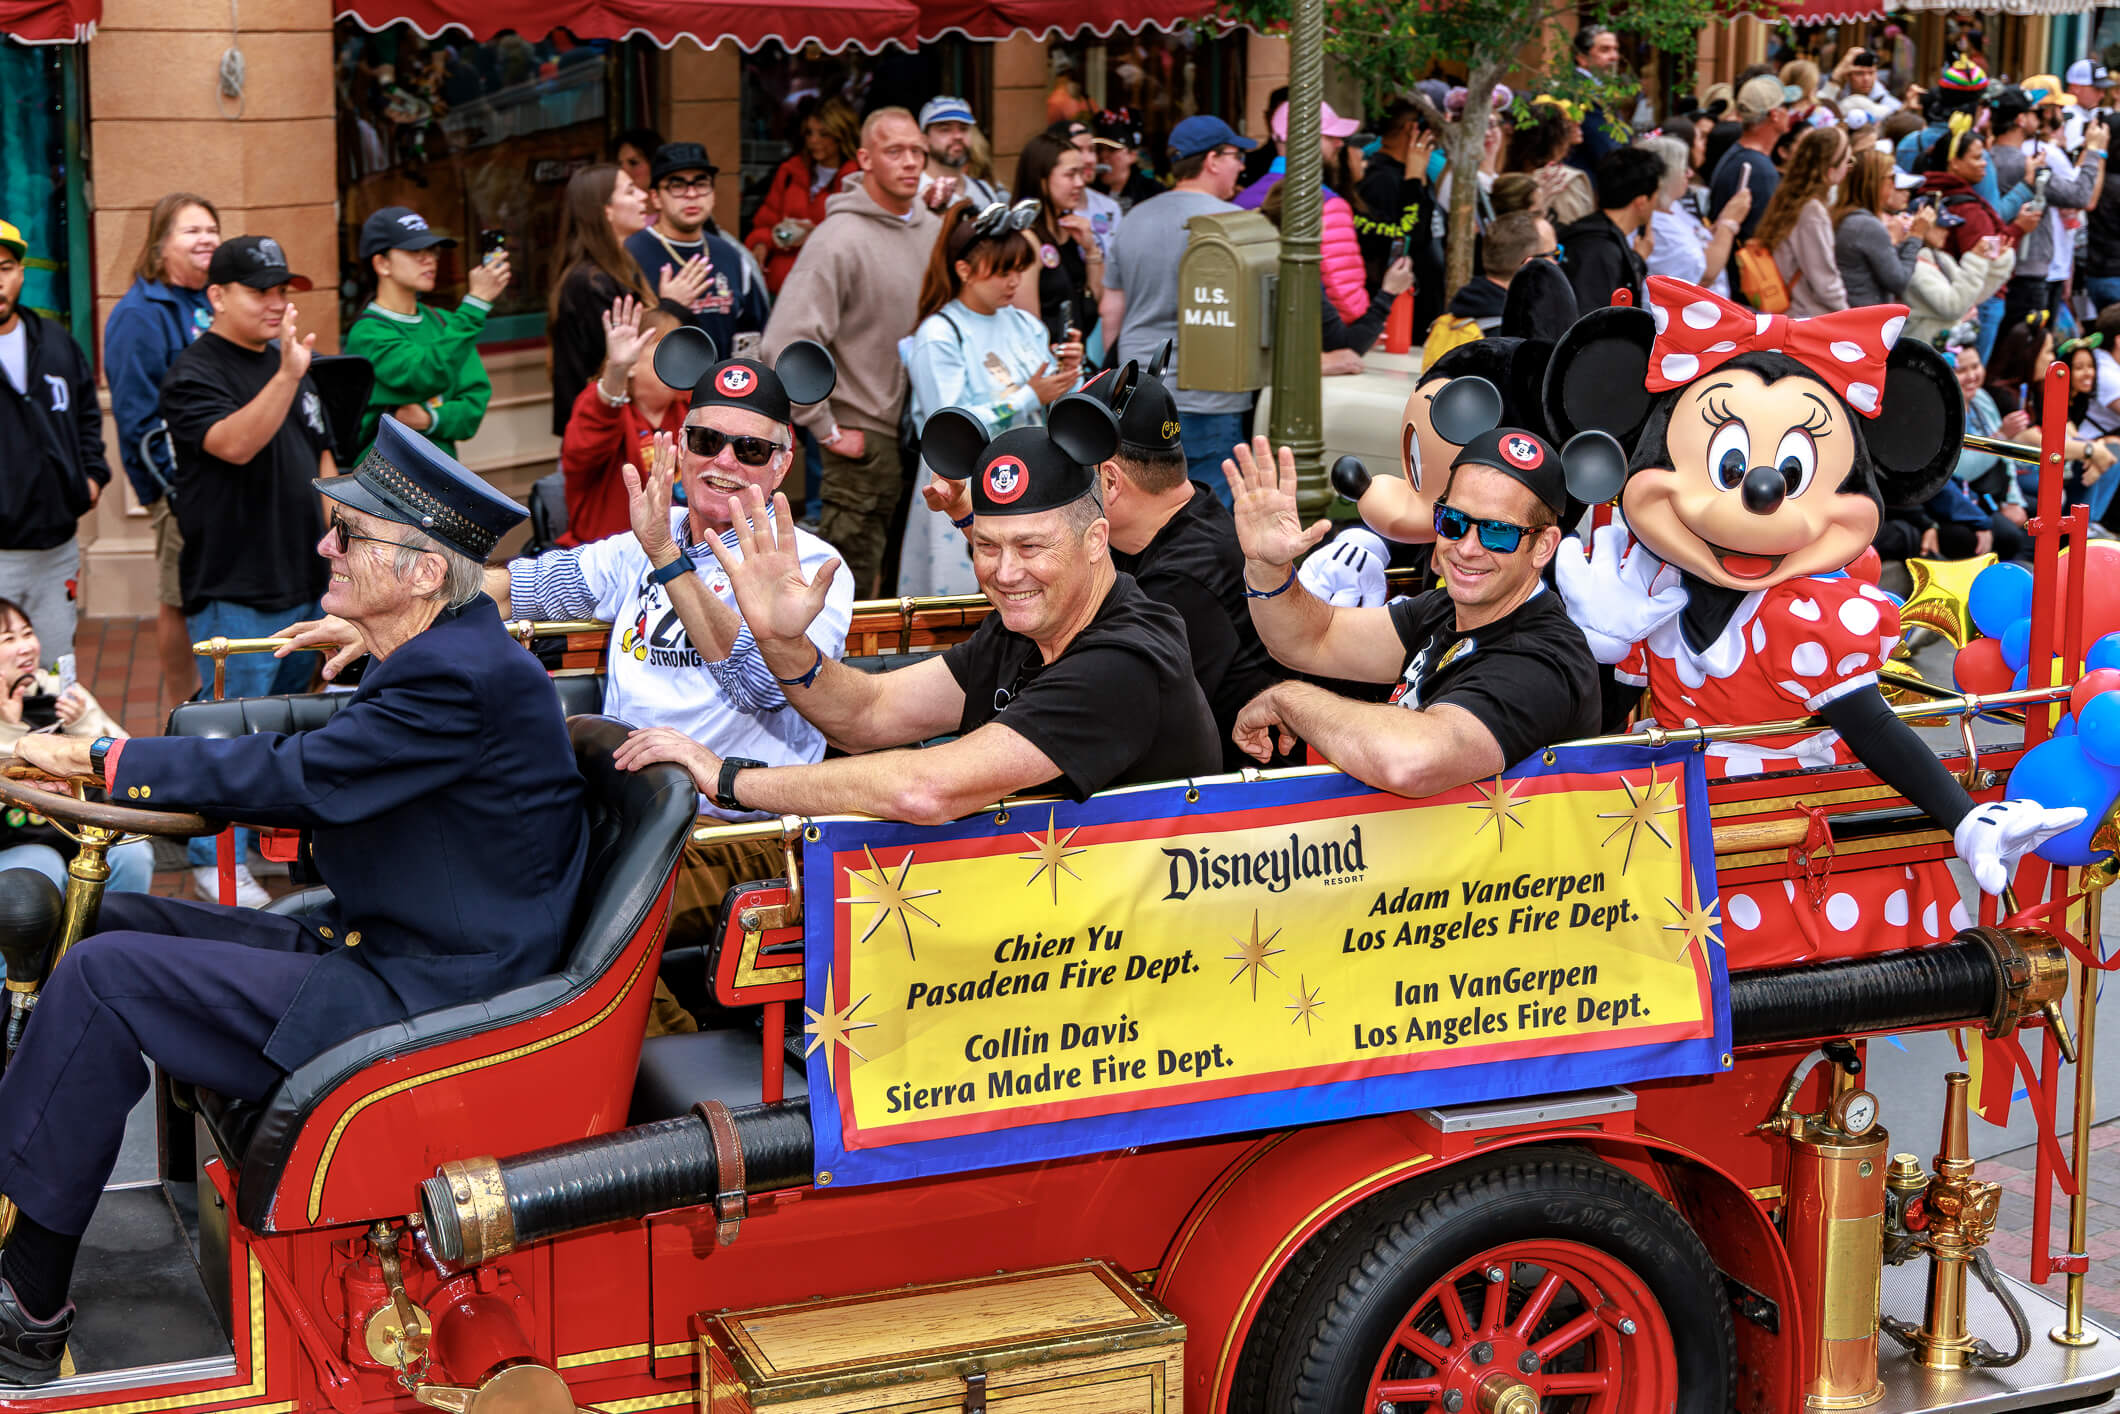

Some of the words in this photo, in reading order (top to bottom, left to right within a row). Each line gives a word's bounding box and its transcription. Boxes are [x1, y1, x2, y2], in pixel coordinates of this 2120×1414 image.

[1184, 308, 1236, 328] MAIL
[1194, 286, 1230, 304] U.S.
[649, 648, 702, 668] STRONG
[1160, 823, 1369, 901] Disneyland
[1323, 874, 1365, 887] RESORT
[1367, 889, 1450, 918] Adam
[1461, 871, 1605, 906] VanGerpen
[994, 931, 1076, 964] Chien
[1087, 924, 1124, 952] Yu
[1342, 927, 1387, 954] Los
[1392, 911, 1499, 949] Angeles
[1508, 904, 1560, 935] Fire
[1569, 898, 1639, 932] Dept.
[906, 969, 1050, 1010] Pasadena
[1059, 958, 1117, 989] Fire
[1124, 949, 1200, 984] Dept.
[1395, 980, 1439, 1007] Ian
[1449, 964, 1598, 1000] VanGerpen
[964, 1025, 1049, 1062] Collin
[1060, 1013, 1139, 1051] Davis
[1354, 1023, 1398, 1050] Los
[1405, 1005, 1508, 1045] Angeles
[1518, 999, 1567, 1030] Fire
[1577, 992, 1650, 1026] Dept.
[886, 1081, 976, 1114] Sierra
[988, 1062, 1082, 1099] Madre
[1092, 1054, 1146, 1085] Fire
[1157, 1043, 1234, 1078] Dept.
